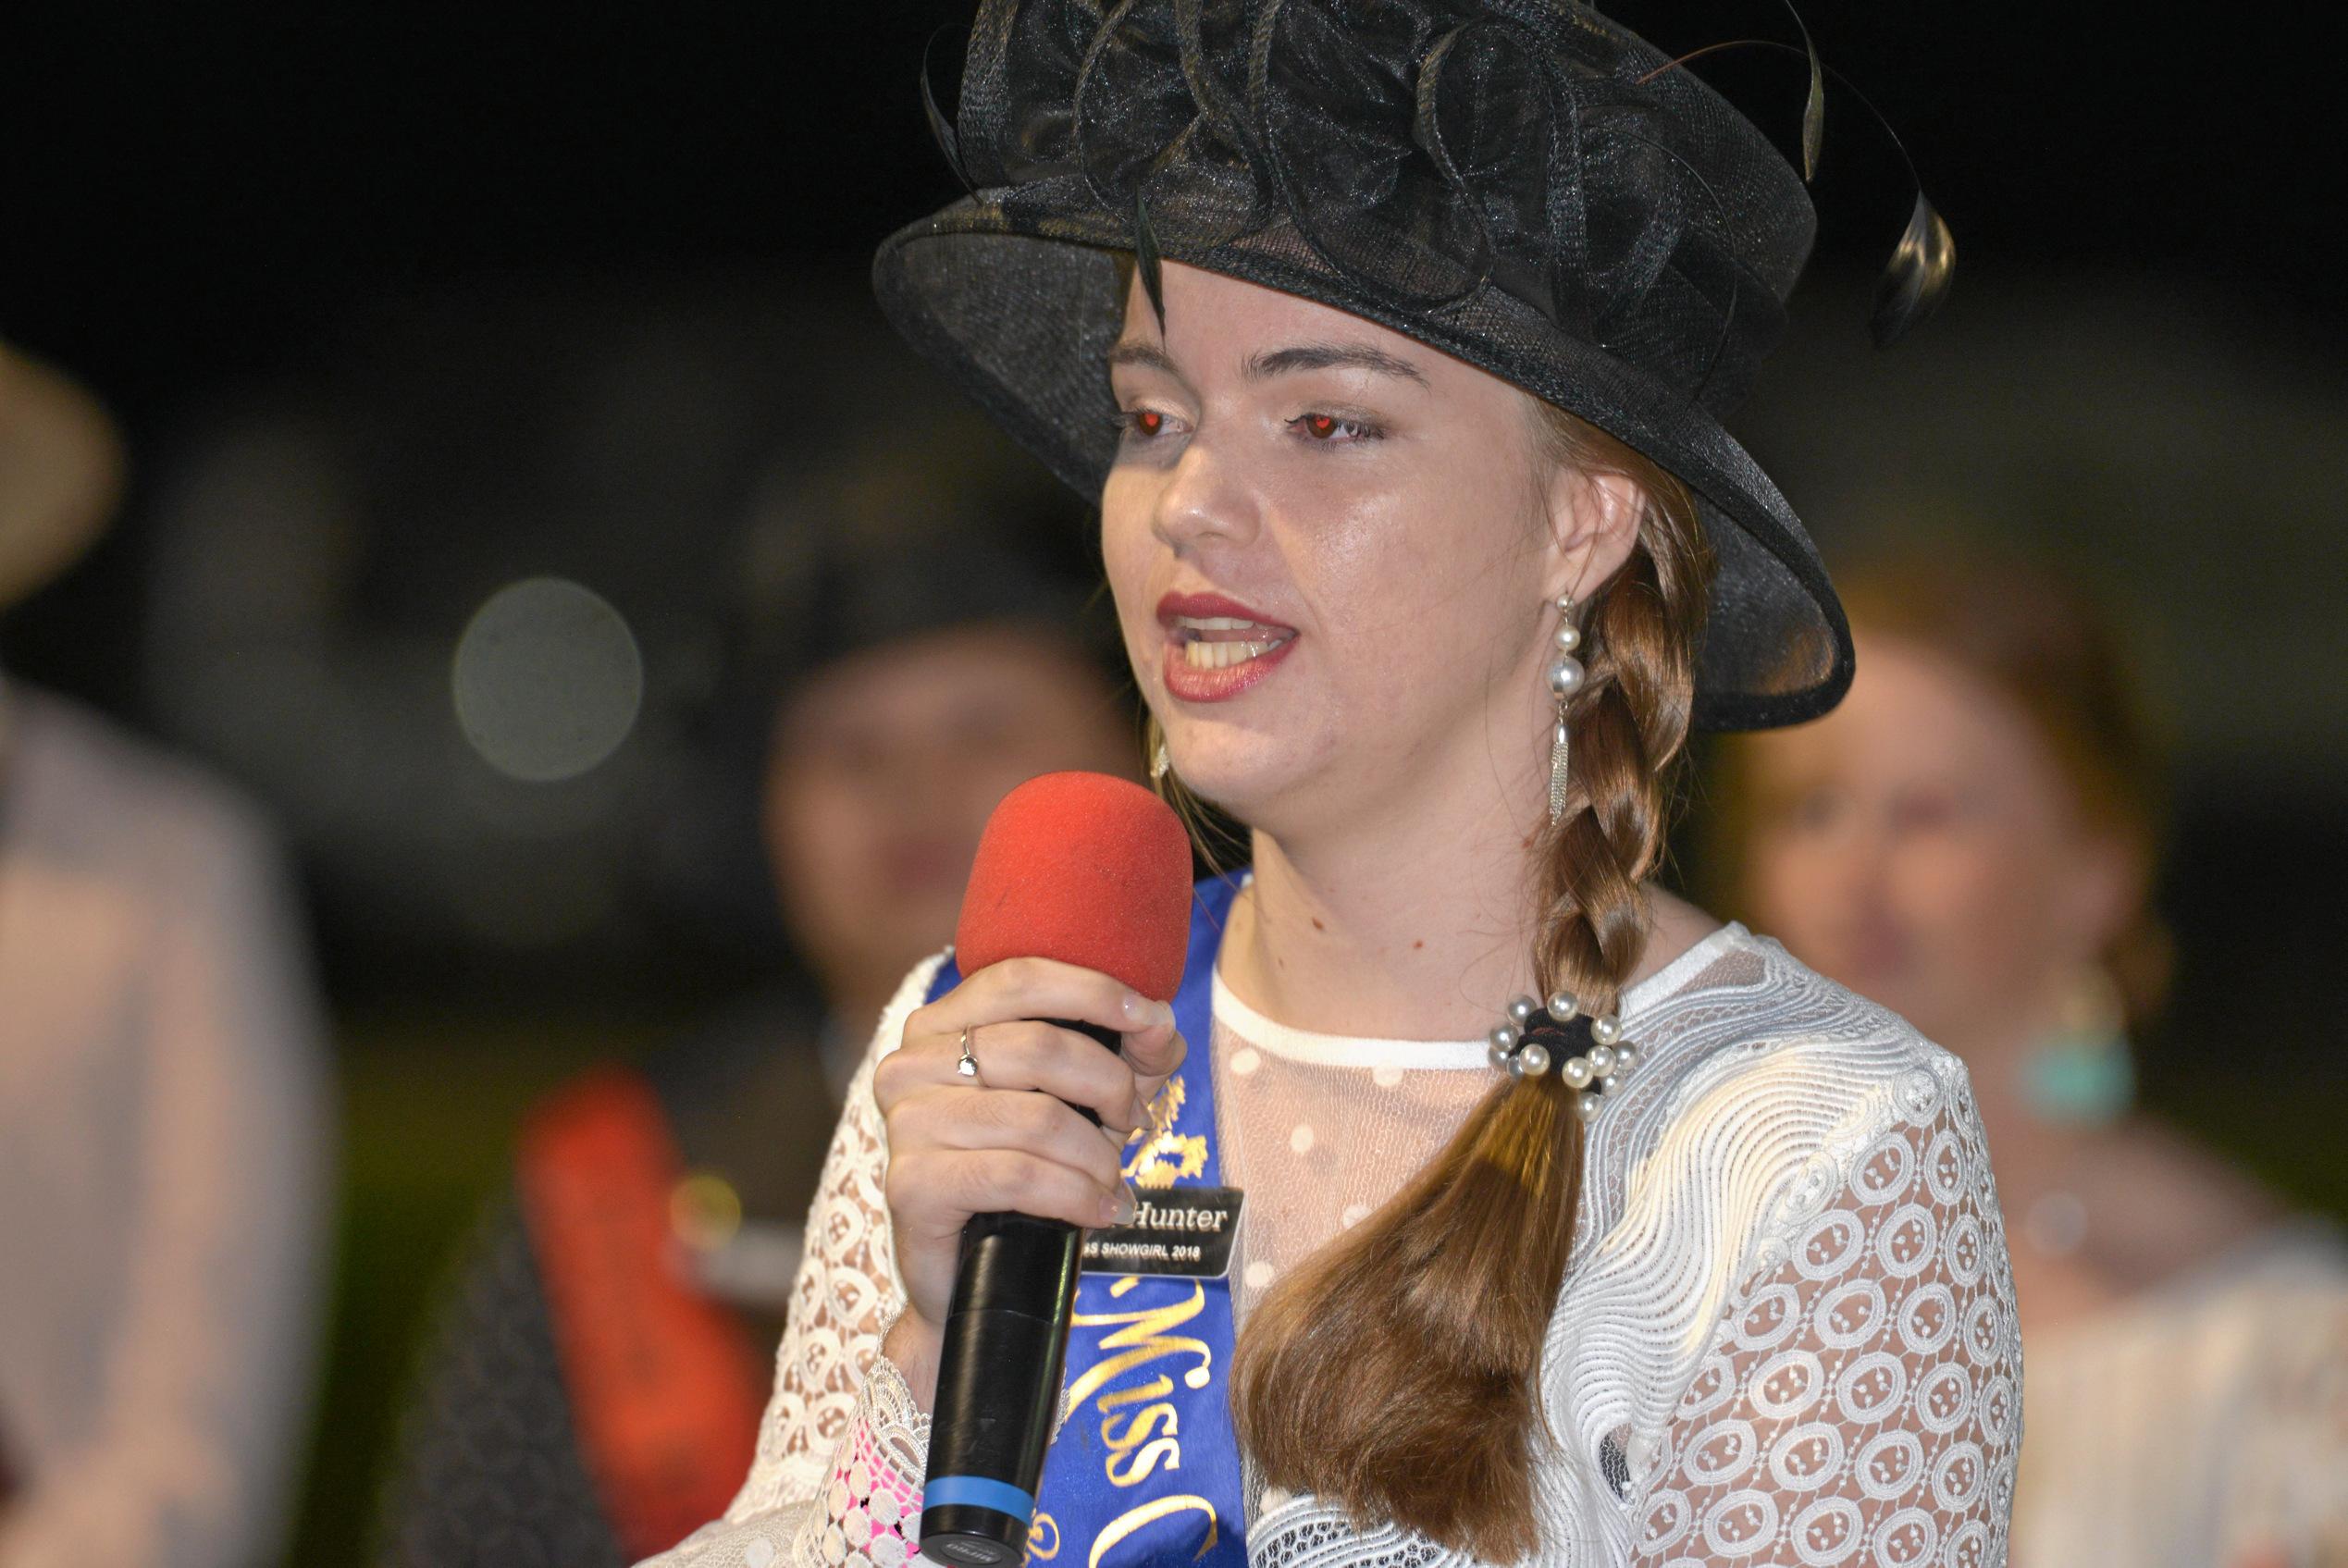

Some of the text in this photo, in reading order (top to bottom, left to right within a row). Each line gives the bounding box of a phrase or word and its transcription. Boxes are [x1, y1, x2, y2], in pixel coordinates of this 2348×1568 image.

[1132, 1200, 1229, 1229] Hunter
[1101, 1241, 1168, 1258] SHOWGIRL
[1170, 1245, 1201, 1260] 2018
[1065, 1278, 1212, 1488] Miss
